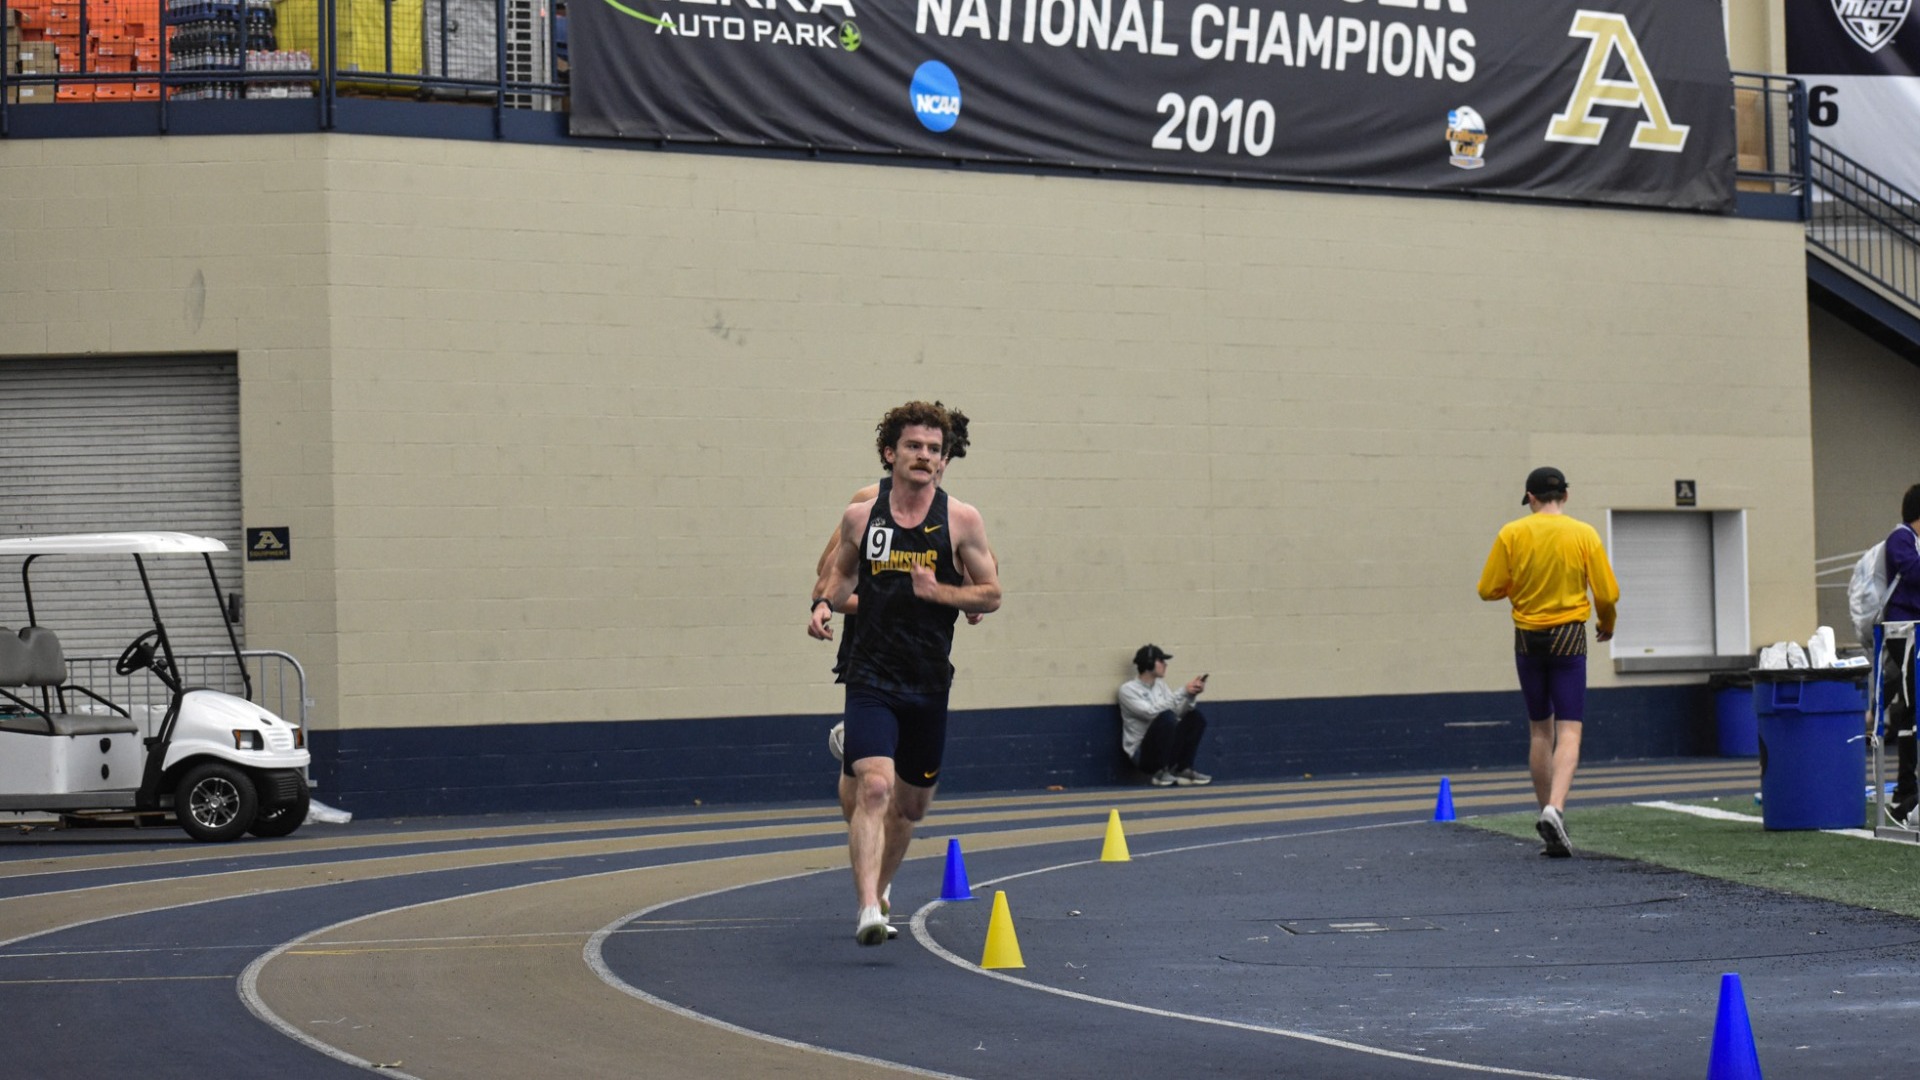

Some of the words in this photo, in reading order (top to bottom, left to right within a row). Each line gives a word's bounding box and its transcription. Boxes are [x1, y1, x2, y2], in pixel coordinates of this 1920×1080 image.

[1839, 0, 1905, 18] MAC
[655, 12, 746, 41] AUTO
[753, 20, 838, 48] PARK
[915, 0, 1179, 56] NATIONAL
[1190, 3, 1476, 82] CHAMPIONS
[1544, 9, 1691, 153] A
[916, 94, 960, 116] NCAA
[1151, 92, 1276, 157] 2010
[254, 531, 284, 549] A
[872, 529, 887, 558] 9
